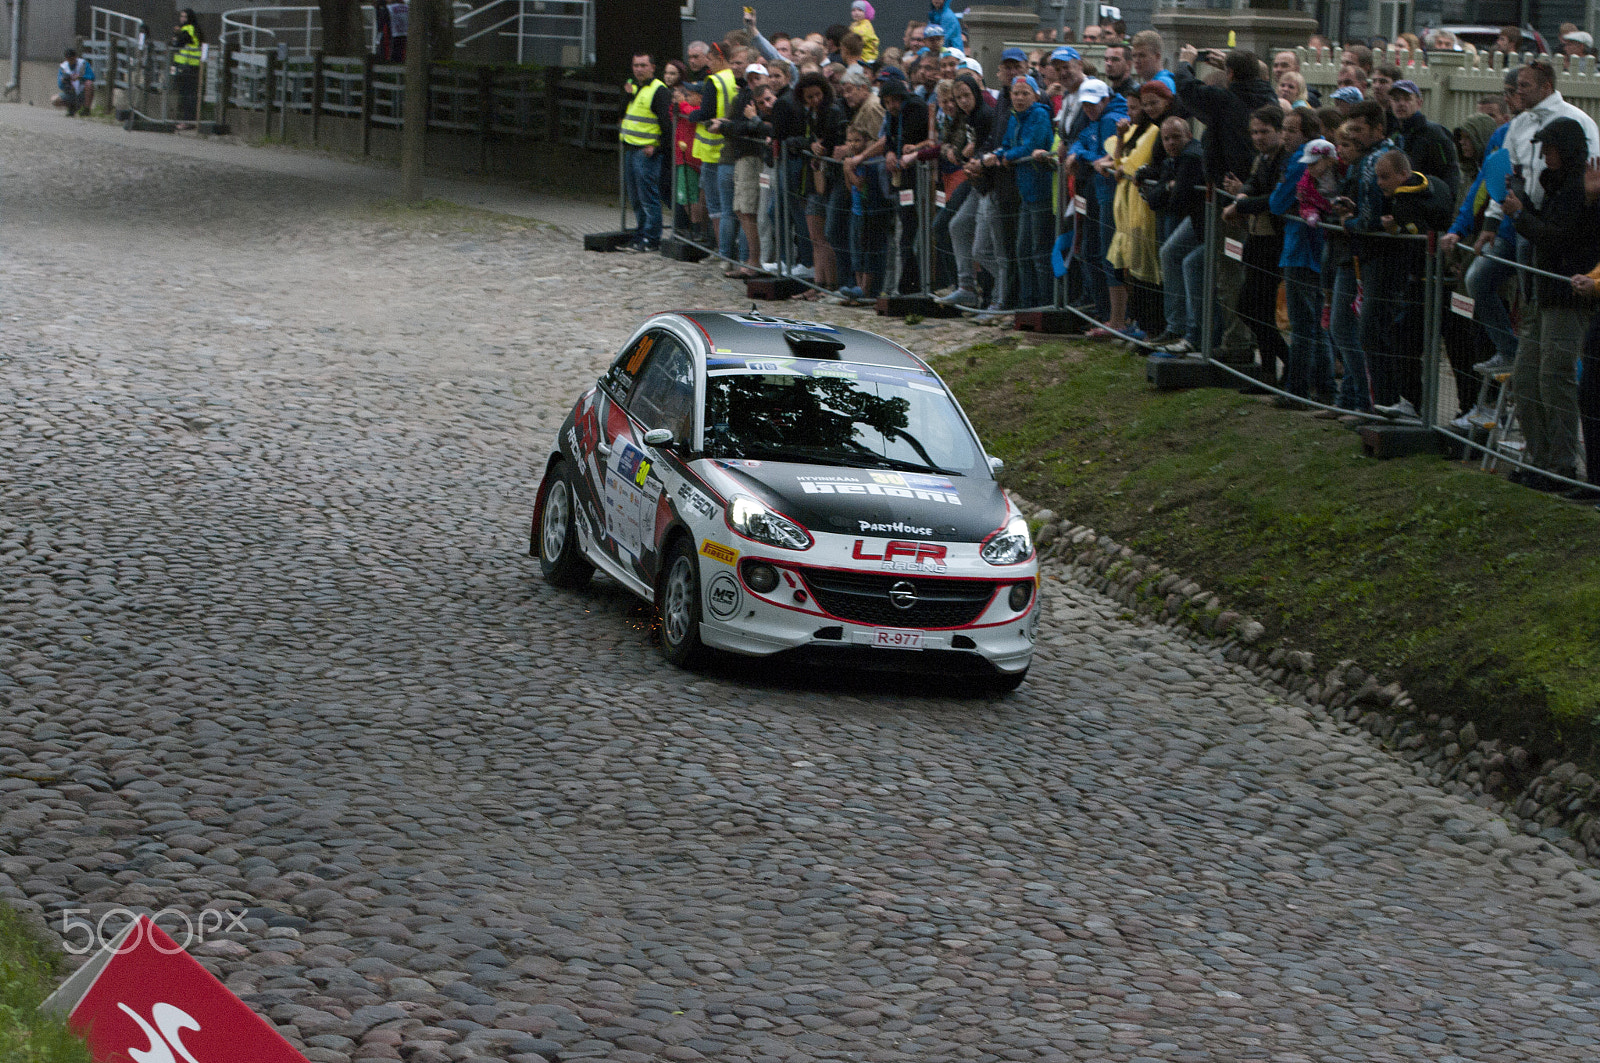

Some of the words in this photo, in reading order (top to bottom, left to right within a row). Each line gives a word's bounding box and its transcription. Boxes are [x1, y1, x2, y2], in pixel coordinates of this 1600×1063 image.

[626, 336, 653, 375] 30
[566, 426, 587, 476] RACING
[636, 461, 650, 486] 30
[868, 471, 905, 486] 30
[704, 542, 736, 563] PIRELLI
[852, 539, 948, 566] LFR
[881, 560, 948, 574] RACING
[877, 631, 920, 646] R-977
